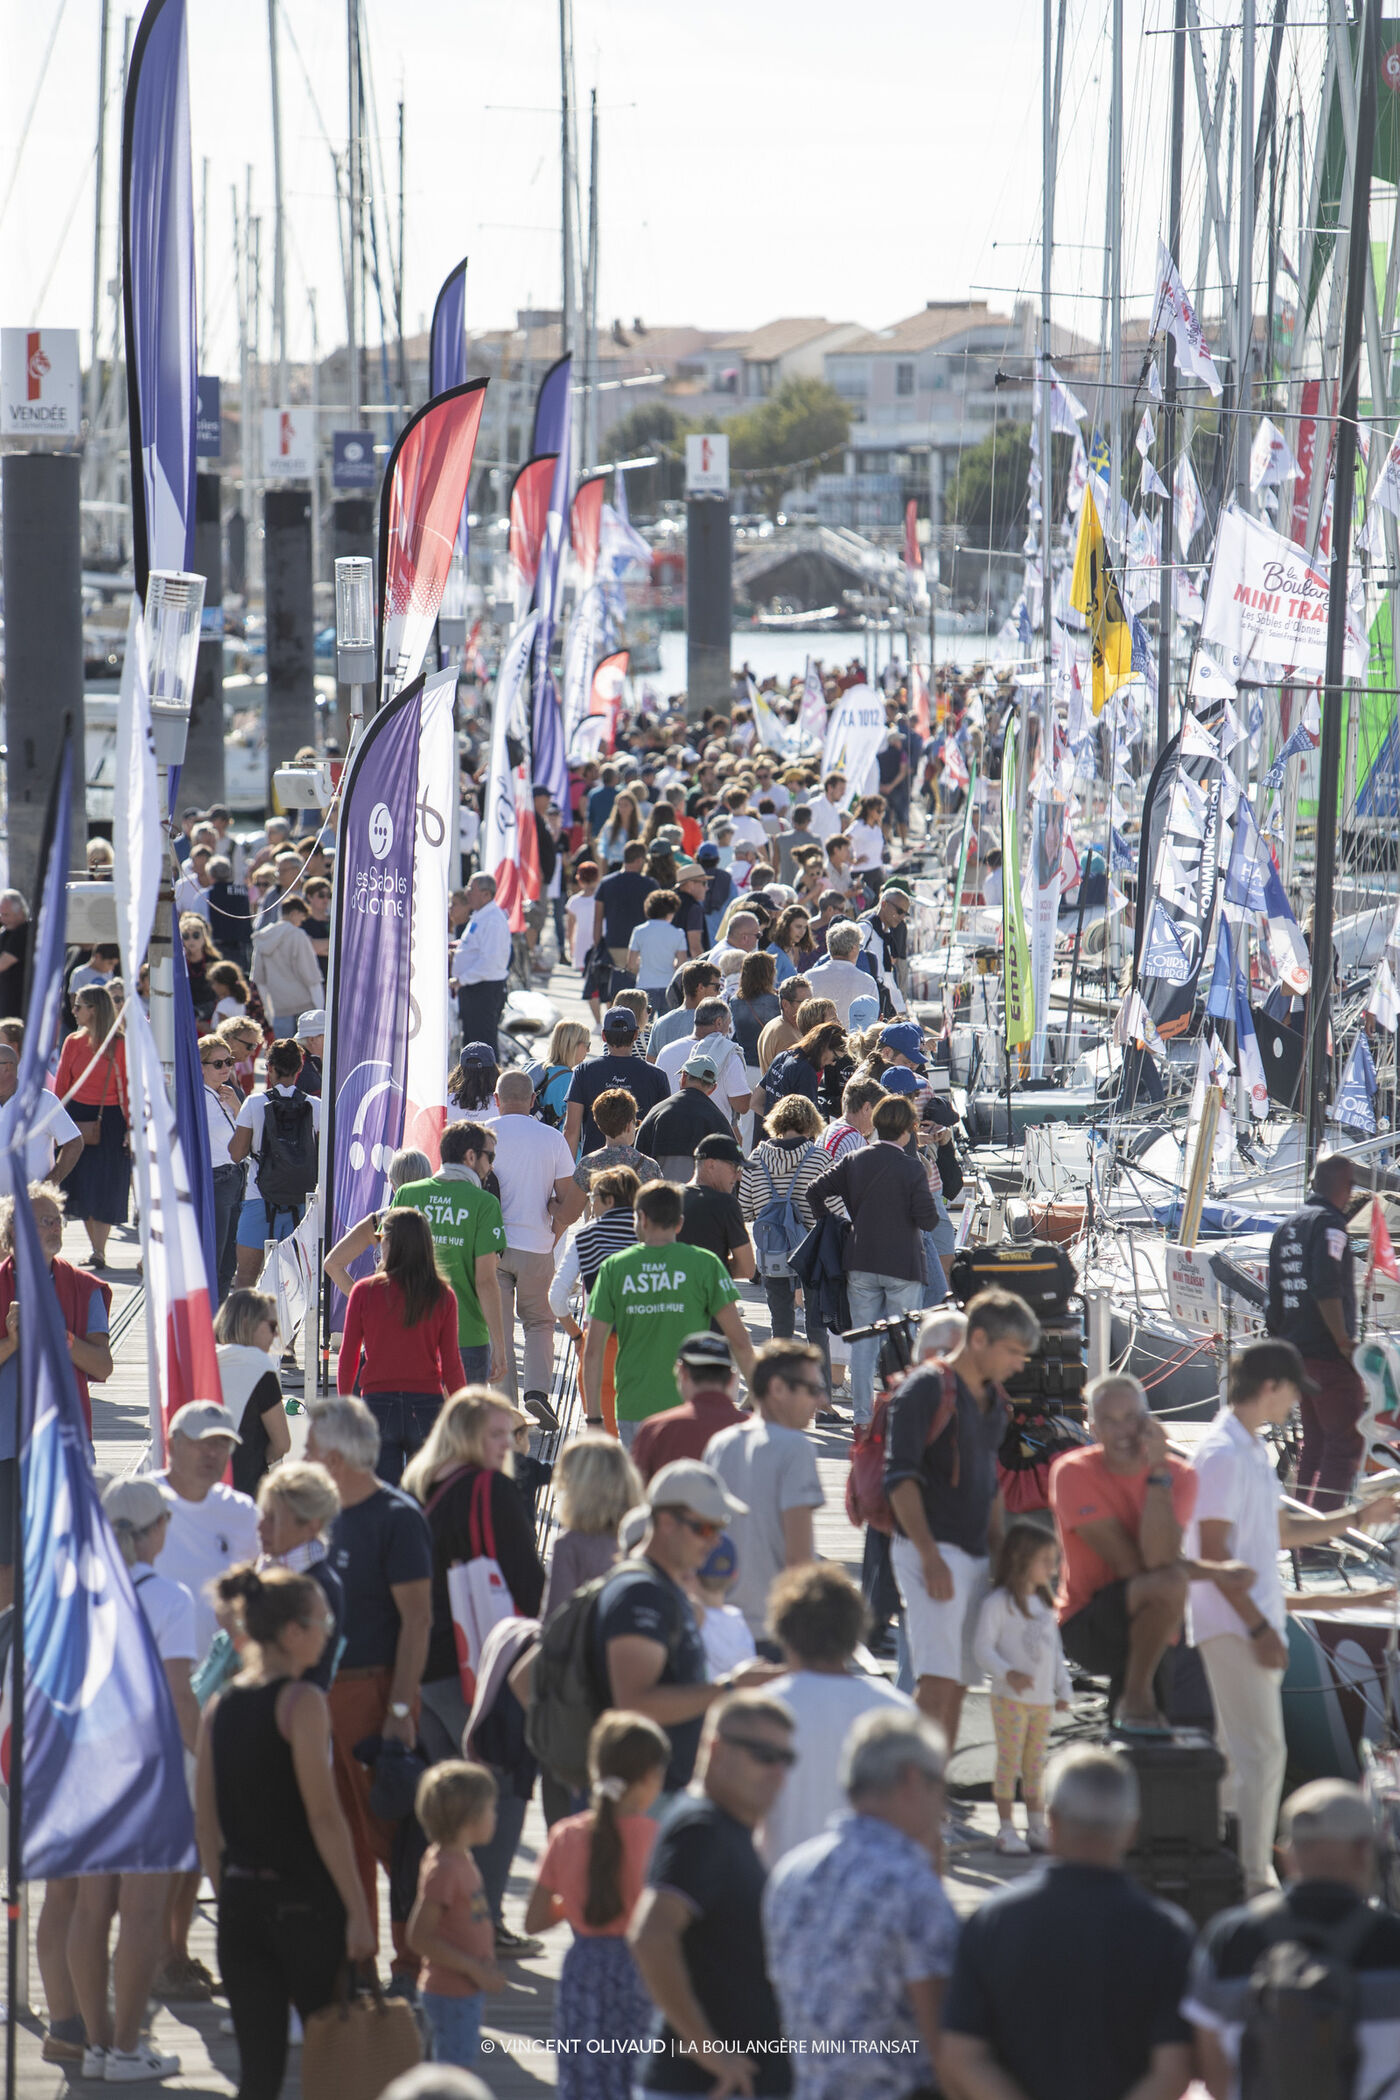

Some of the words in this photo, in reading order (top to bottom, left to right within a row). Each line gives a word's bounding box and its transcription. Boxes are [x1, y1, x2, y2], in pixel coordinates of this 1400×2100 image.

[9, 403, 67, 420] VENDÉE
[1233, 583, 1281, 615] MINI
[1288, 598, 1329, 624] TRA
[1241, 607, 1254, 621] Les
[1256, 612, 1282, 630] Sables
[430, 1195, 451, 1205] TEAM
[449, 1237, 464, 1247] HUE
[622, 1271, 687, 1295] ASTAP
[666, 1303, 684, 1313] HUE
